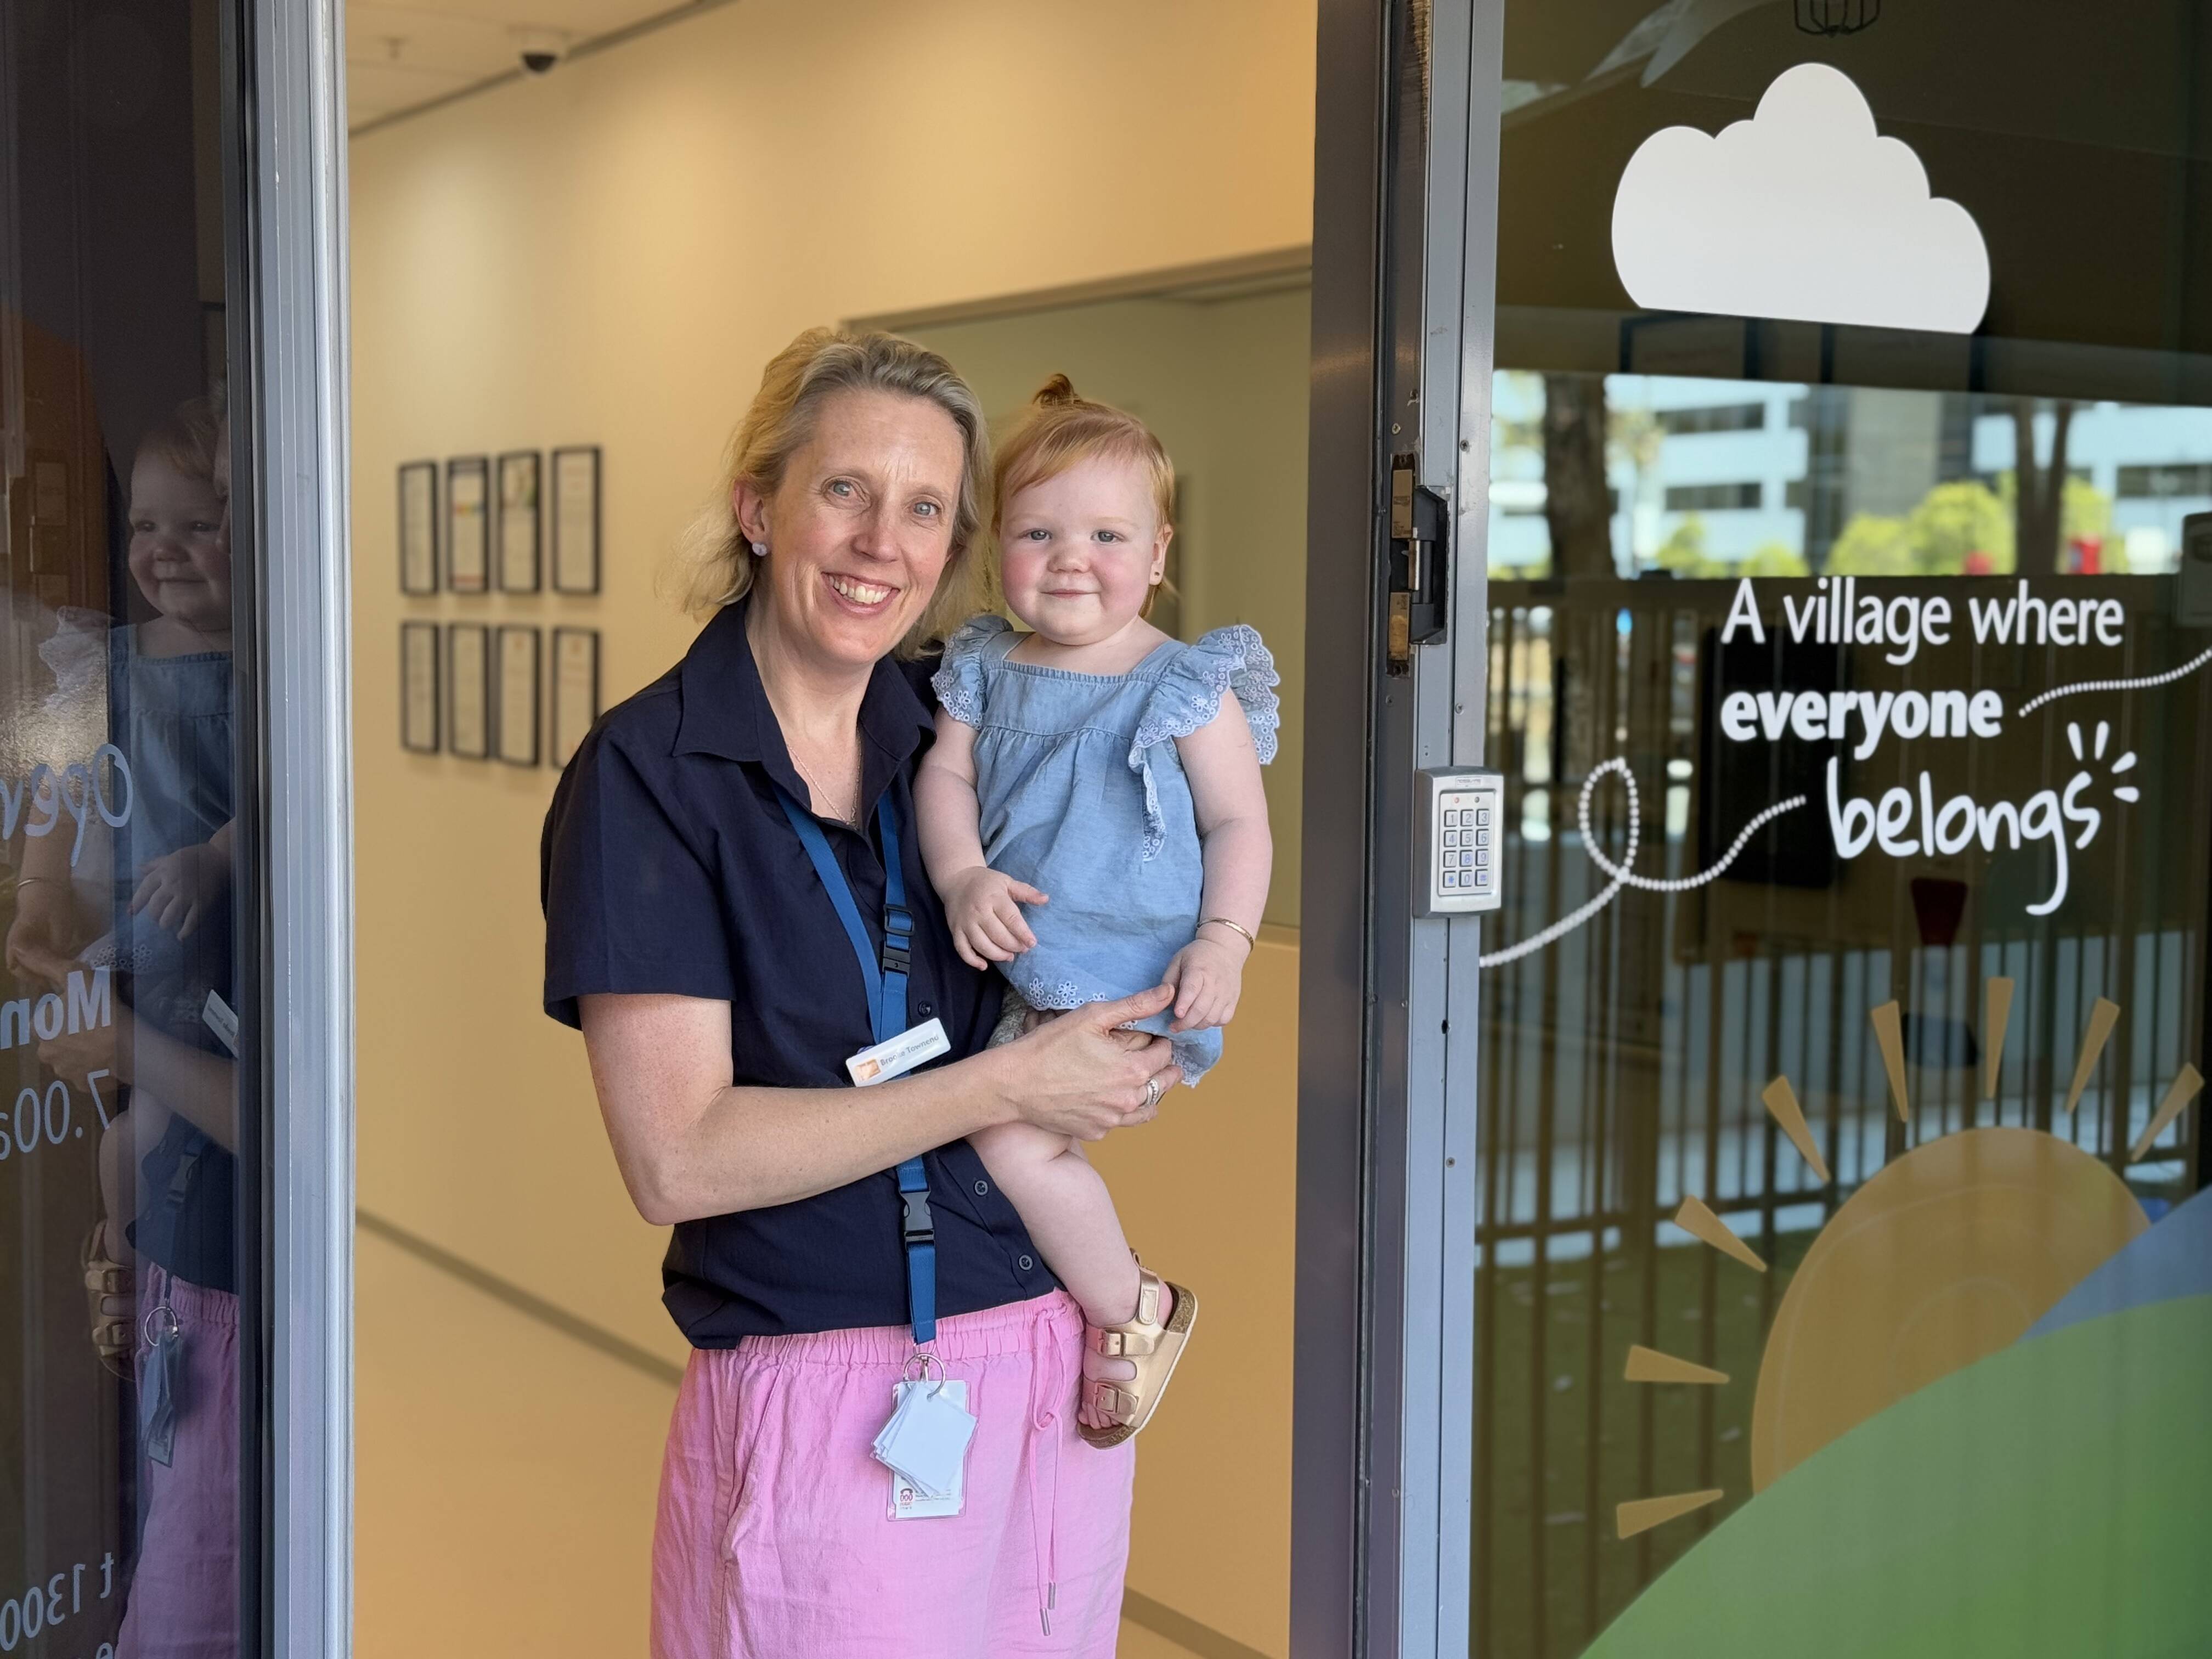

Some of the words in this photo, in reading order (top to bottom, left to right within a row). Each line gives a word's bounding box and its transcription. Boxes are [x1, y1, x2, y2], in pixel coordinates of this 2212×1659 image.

[1721, 577, 1765, 644] A
[1783, 575, 1952, 665] village
[1968, 579, 2124, 646] where
[1720, 690, 2003, 760] everyone
[1465, 813, 1471, 823] 2
[1481, 812, 1487, 822] 3
[1449, 834, 1454, 843] 4
[1465, 833, 1471, 843] 5
[1481, 833, 1487, 843] 6
[1827, 757, 2101, 916] belongs
[1449, 854, 1454, 865] 7
[1465, 854, 1471, 864] 8
[1481, 853, 1486, 862] 9
[1464, 874, 1470, 884] 0
[880, 1051, 905, 1066] Brooe
